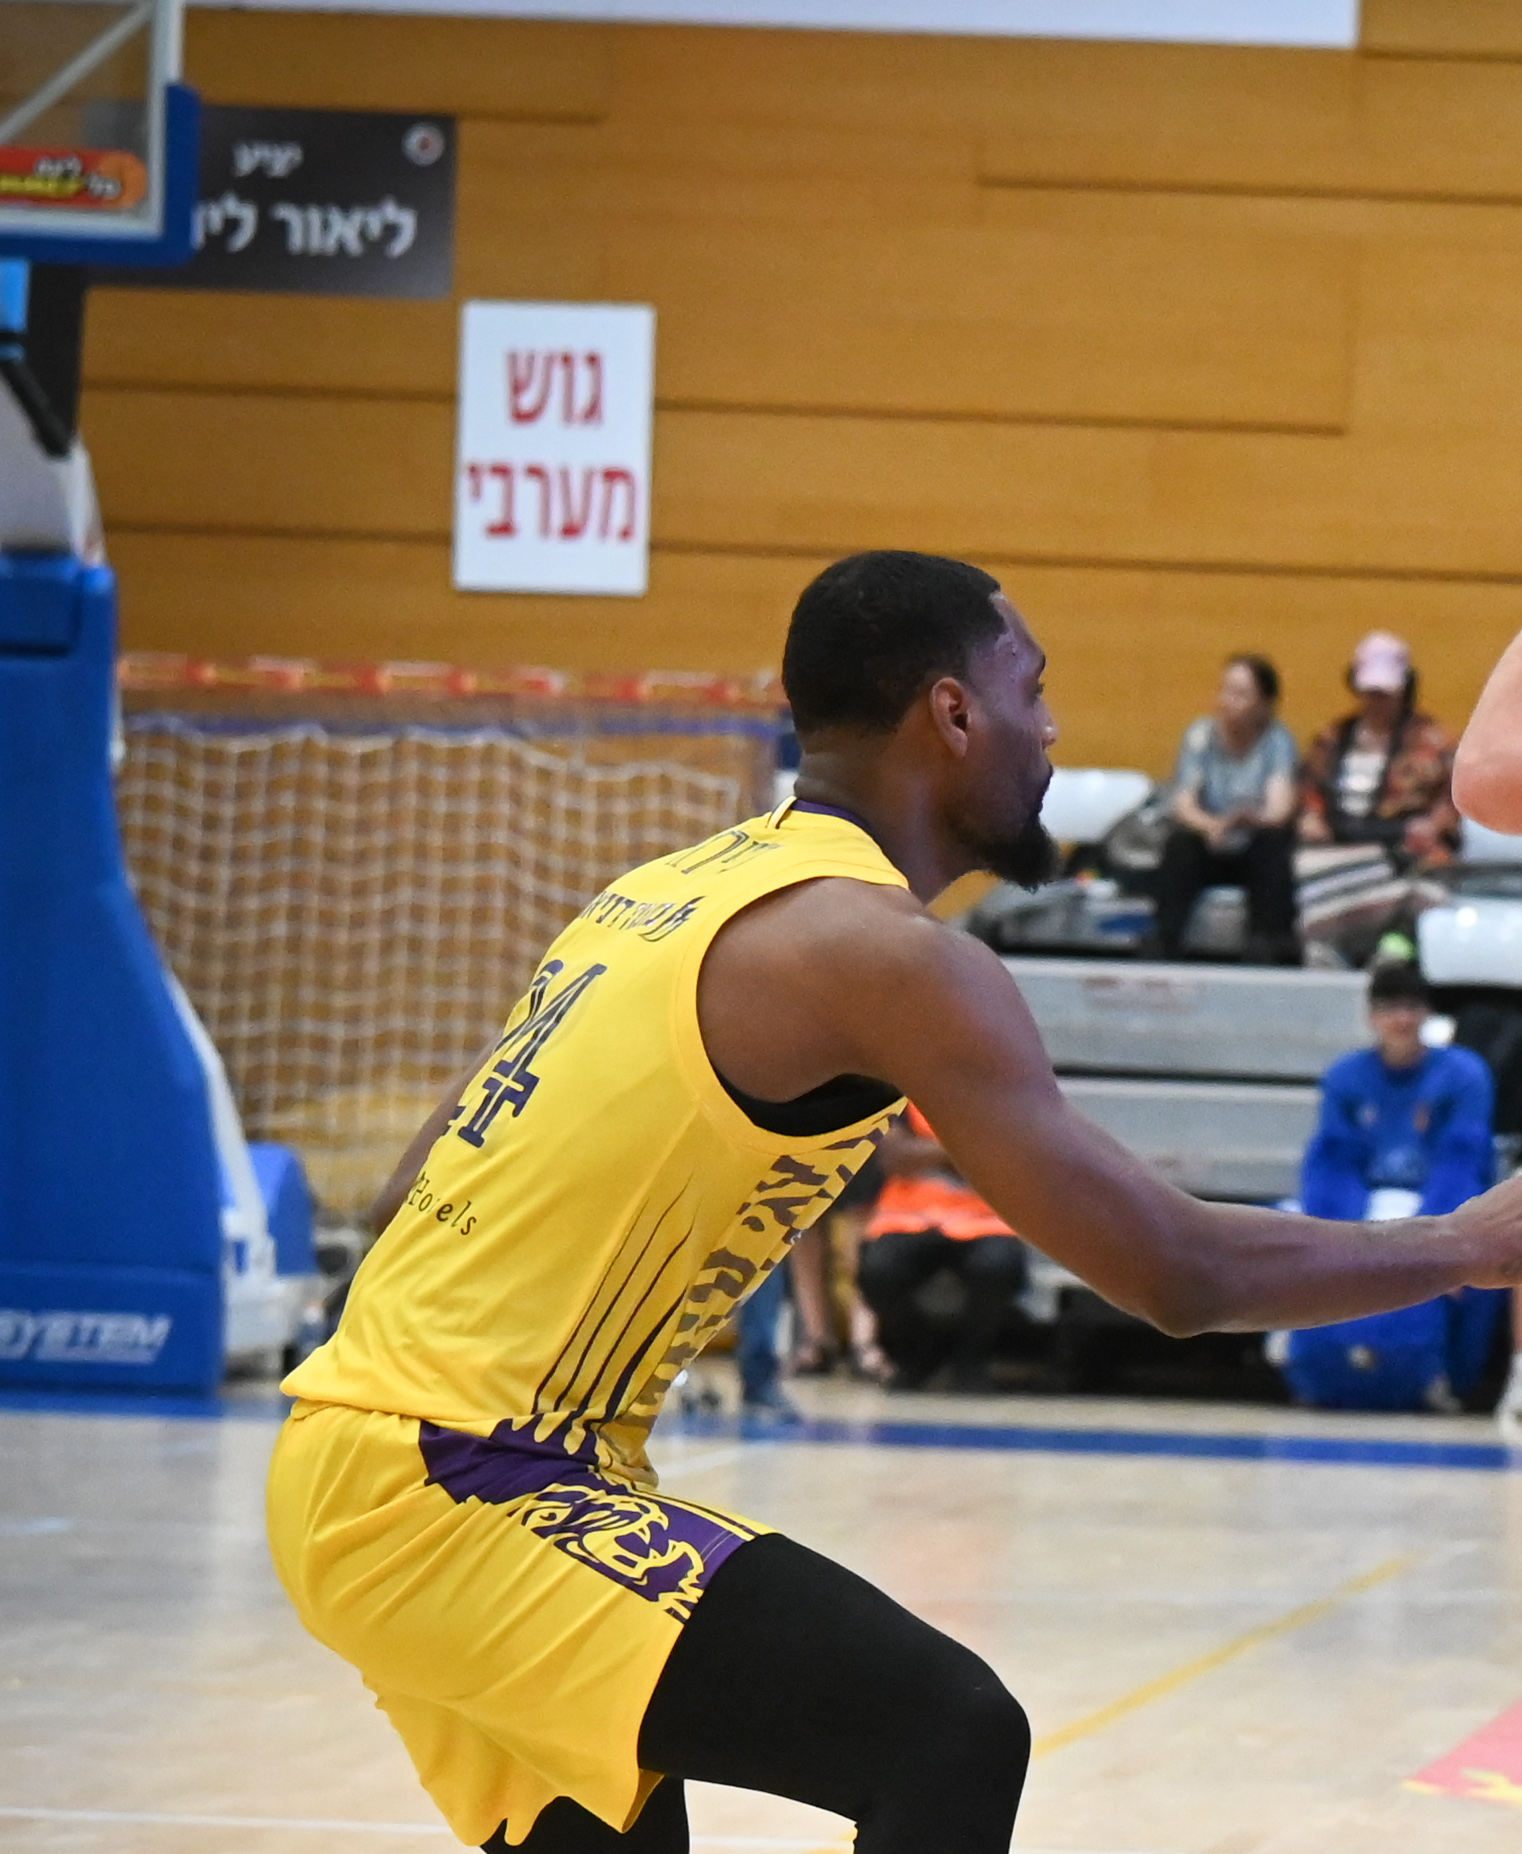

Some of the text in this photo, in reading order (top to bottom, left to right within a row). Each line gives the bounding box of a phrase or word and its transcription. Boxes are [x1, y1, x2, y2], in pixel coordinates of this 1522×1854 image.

[268, 192, 418, 258] ליאור
[506, 349, 603, 427] גוש
[467, 460, 637, 542] מערבי
